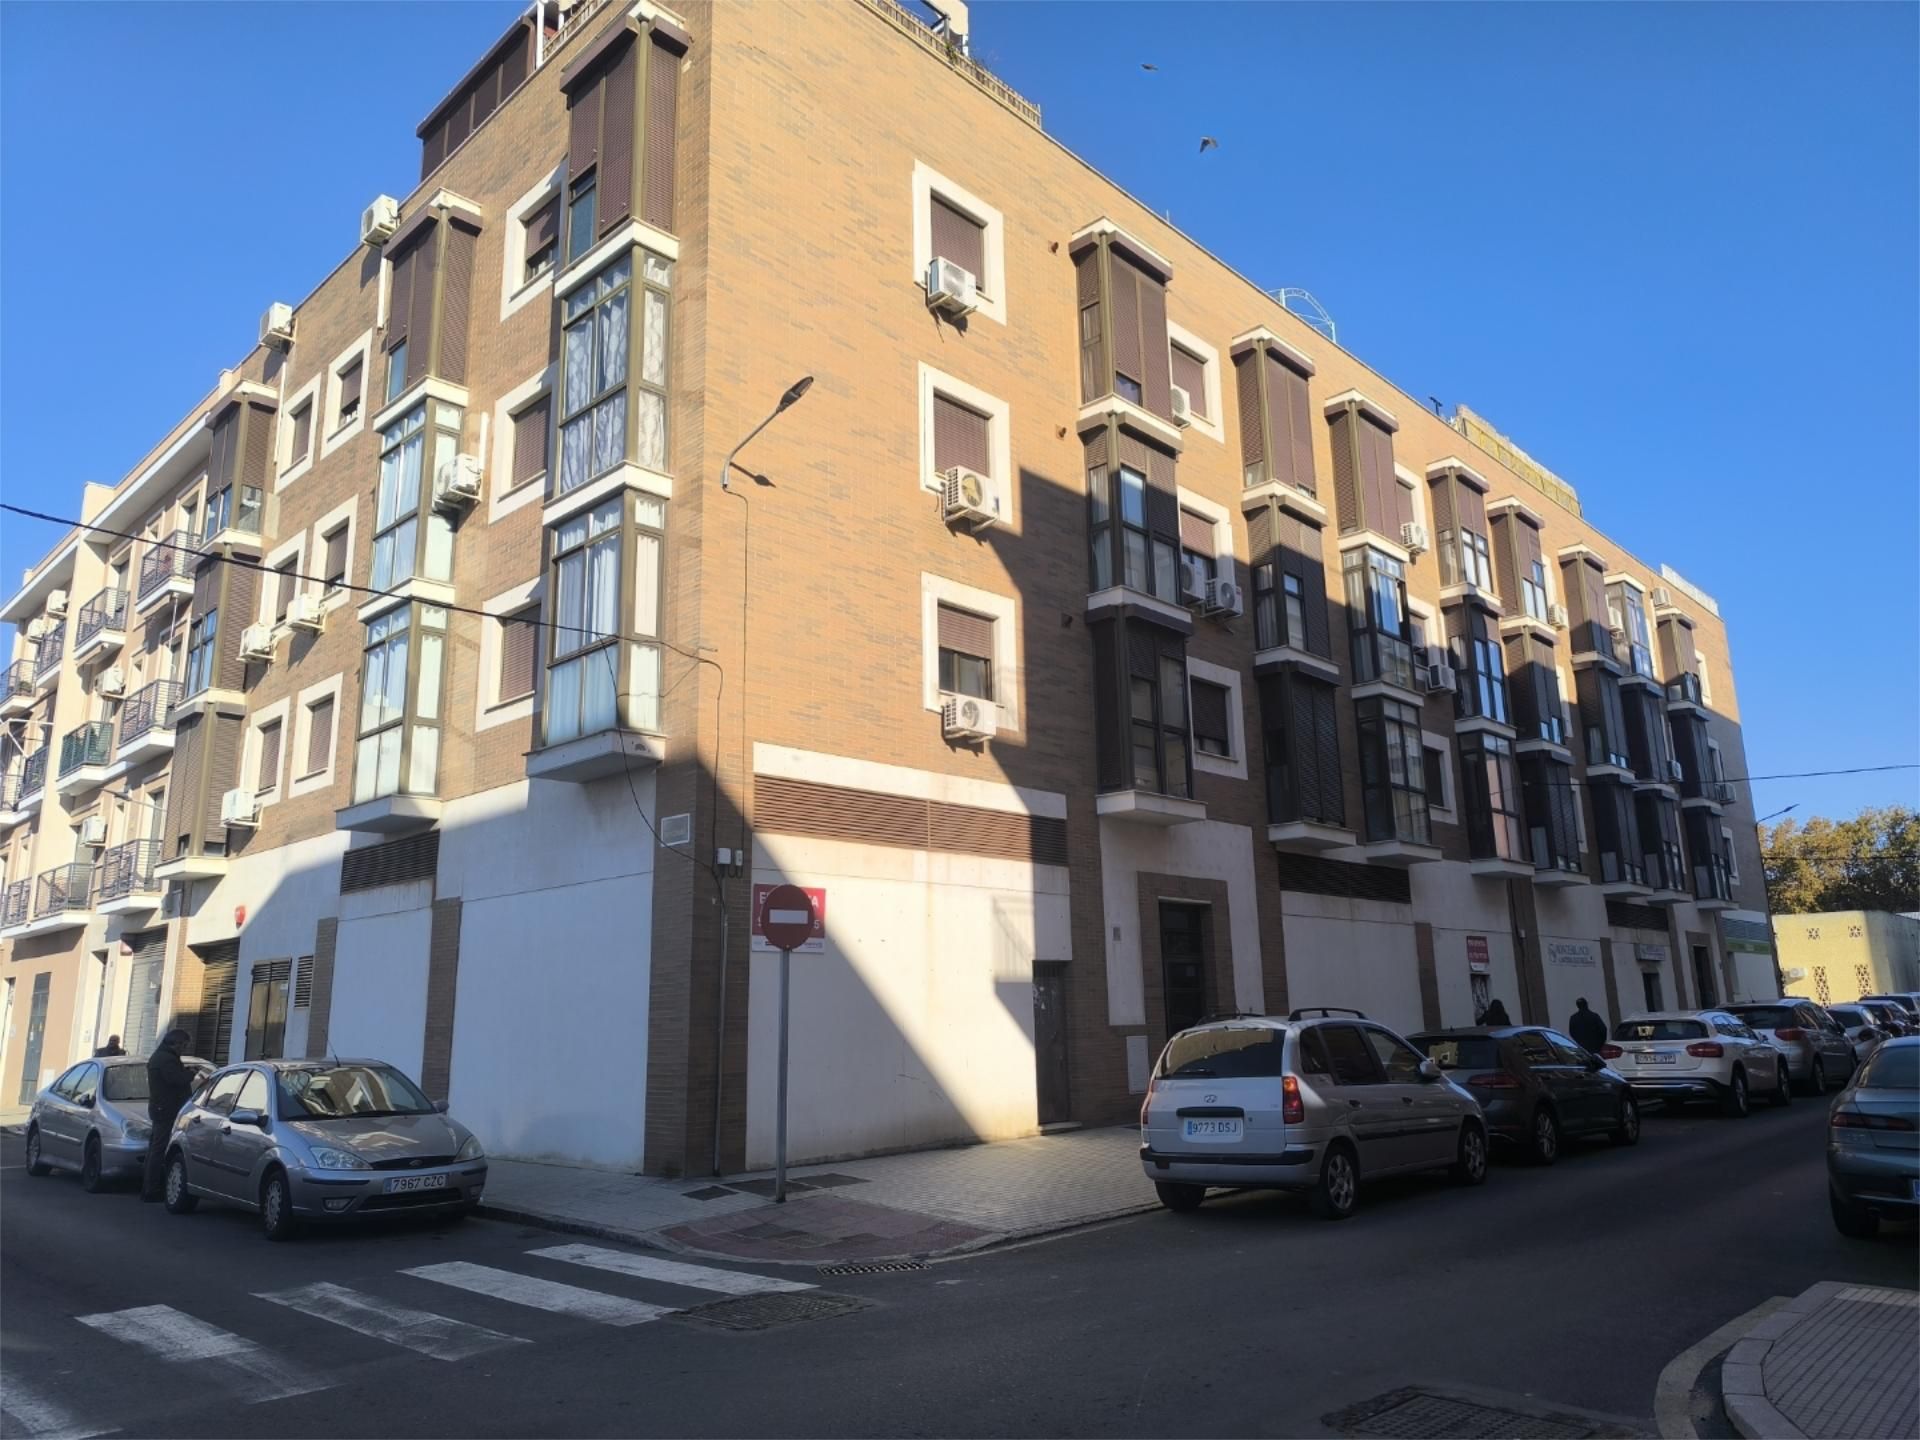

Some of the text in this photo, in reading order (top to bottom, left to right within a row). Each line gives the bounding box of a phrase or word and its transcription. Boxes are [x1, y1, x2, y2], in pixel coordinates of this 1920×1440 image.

[1192, 1121, 1237, 1133] 9773 DSJ
[393, 1175, 444, 1191] 7967 CZC
